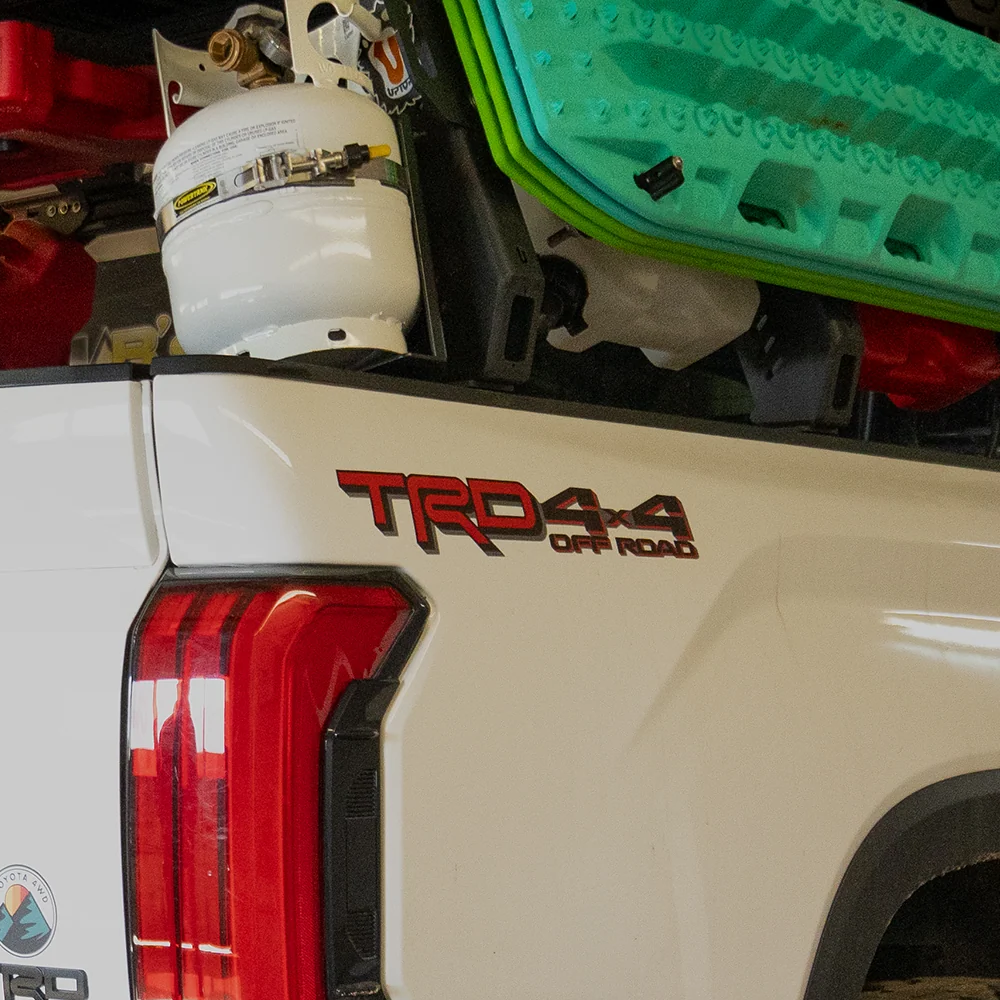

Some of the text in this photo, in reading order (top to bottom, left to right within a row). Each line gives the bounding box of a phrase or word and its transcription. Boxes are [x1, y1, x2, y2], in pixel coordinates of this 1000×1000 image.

[336, 469, 695, 557] TRD 4x4
[549, 533, 700, 560] OFF ROAD
[32, 879, 49, 903] AWD
